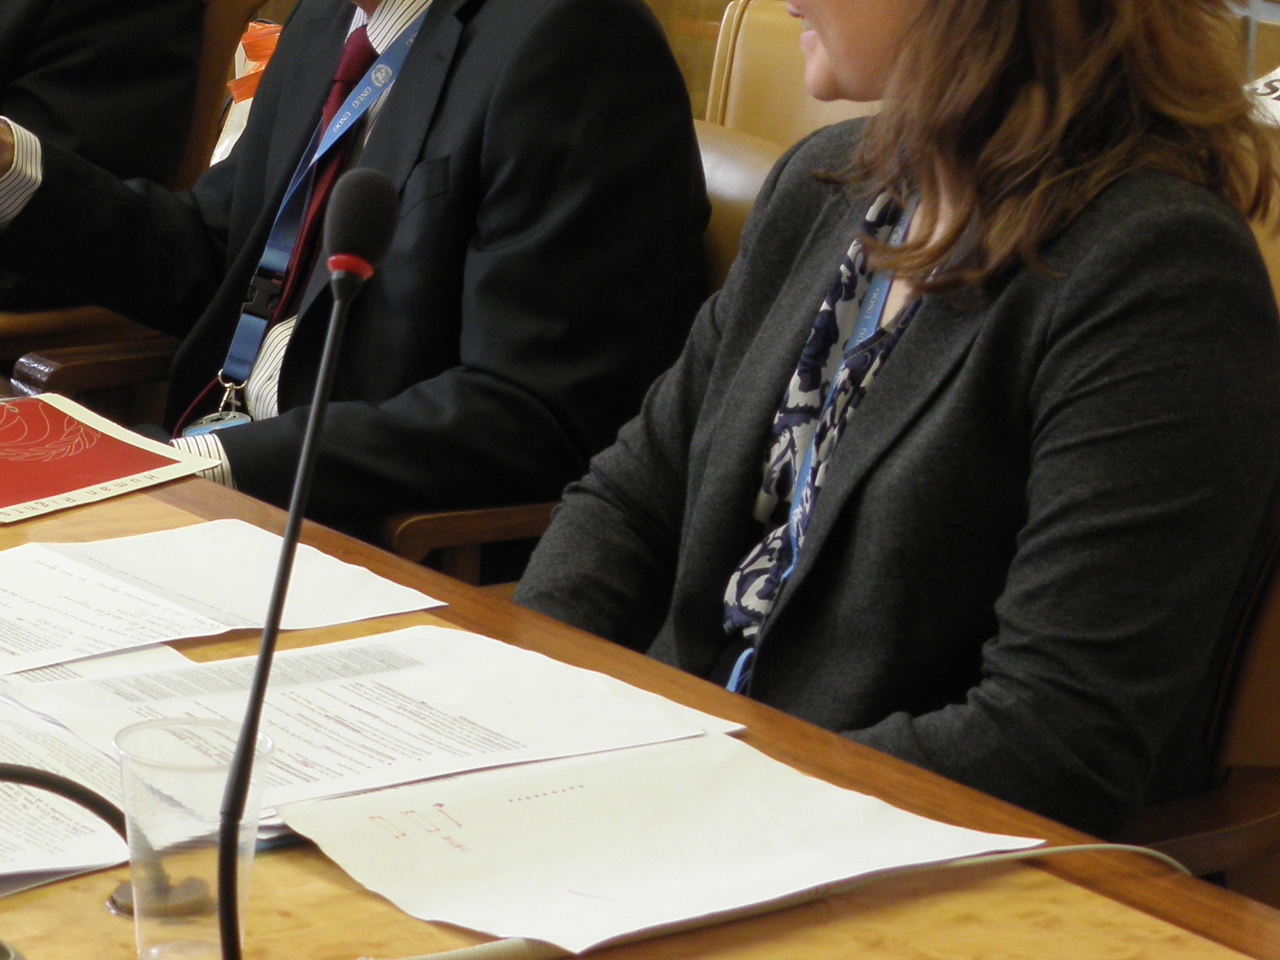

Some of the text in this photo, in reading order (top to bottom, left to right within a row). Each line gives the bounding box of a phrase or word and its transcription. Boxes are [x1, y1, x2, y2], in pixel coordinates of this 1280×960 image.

[333, 86, 372, 133] ONUG UNOG
[865, 288, 880, 319] UNOG
[0, 474, 160, 518] Human Rights
